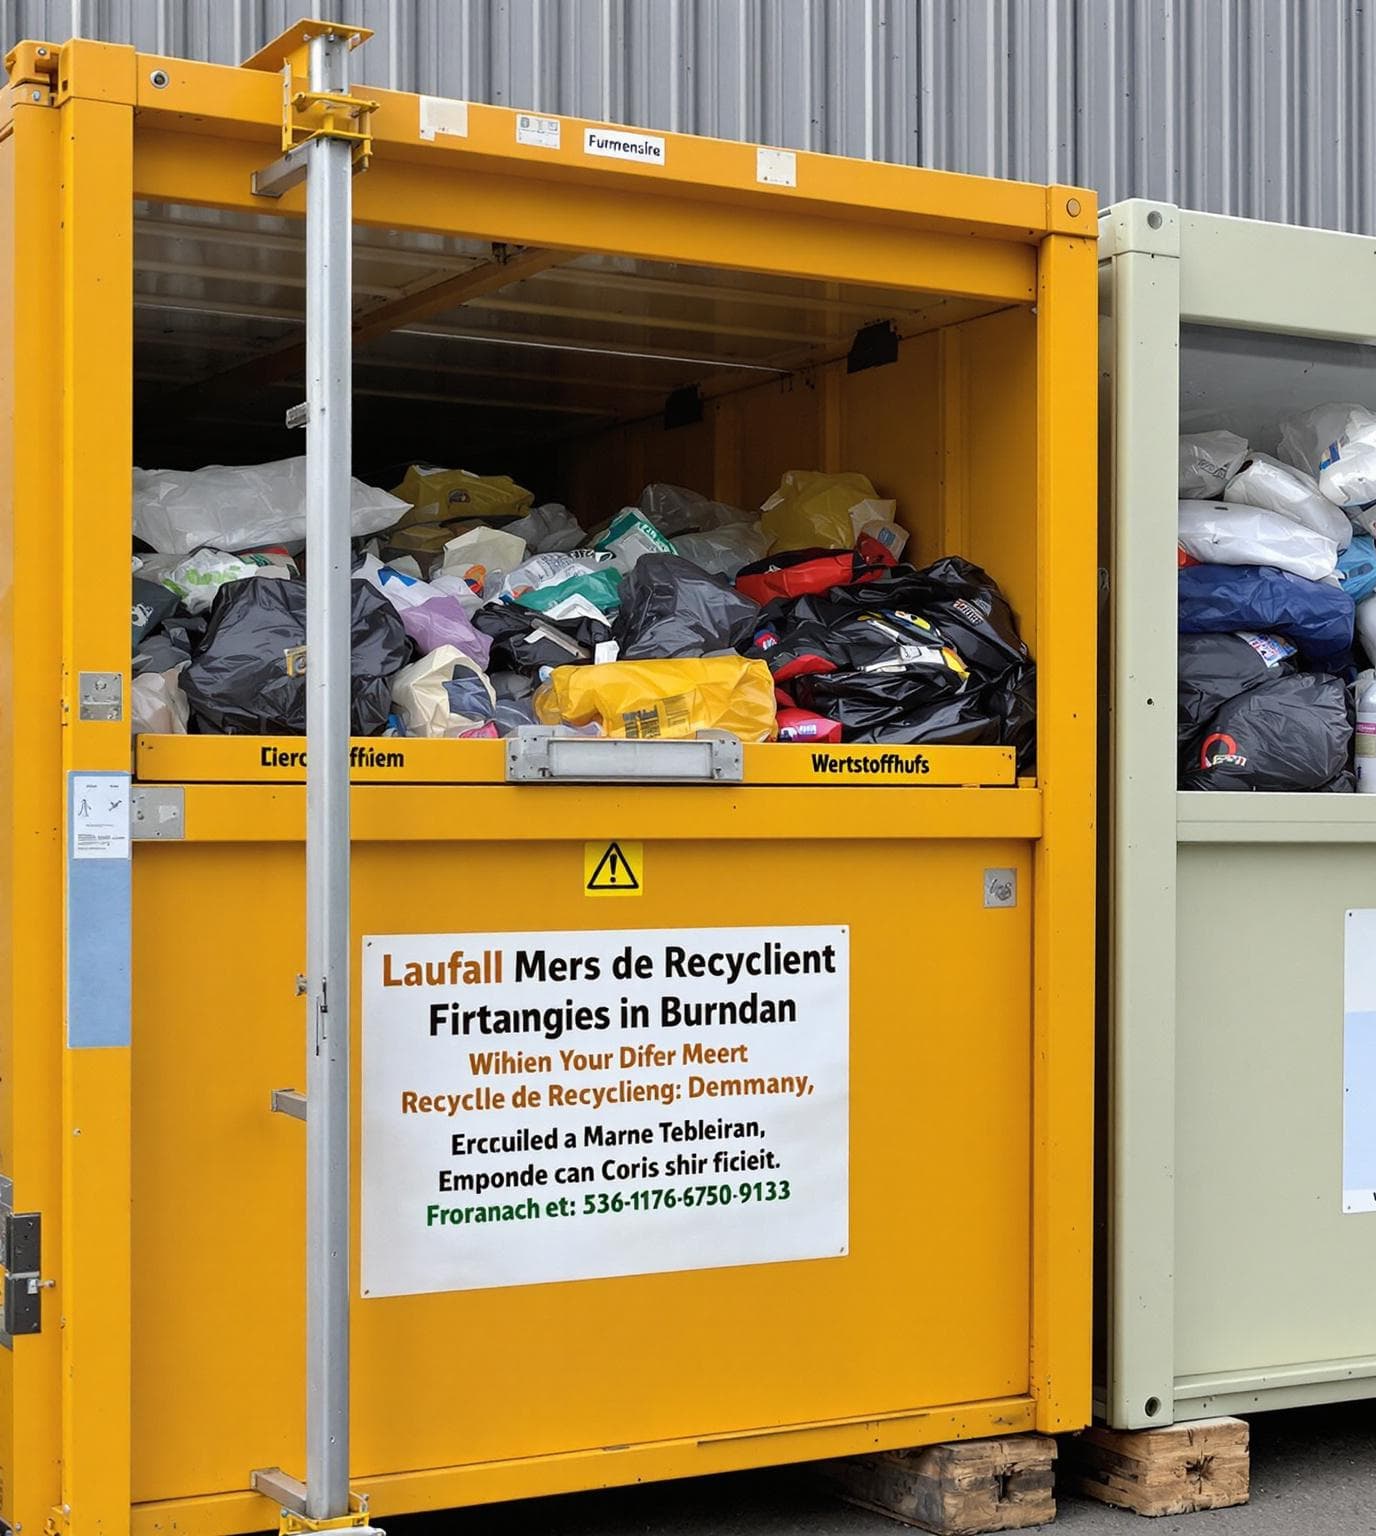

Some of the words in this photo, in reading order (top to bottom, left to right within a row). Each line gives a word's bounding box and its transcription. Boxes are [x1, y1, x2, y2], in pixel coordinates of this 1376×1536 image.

[812, 754, 929, 773] Wertstoffhufs
[384, 951, 502, 987] Laufall
[516, 951, 600, 982] Mers
[613, 946, 653, 979] de
[666, 942, 835, 984] Recyclient
[621, 997, 649, 1028] in
[662, 992, 796, 1027] Burndan
[469, 1051, 551, 1075] Wihien
[560, 1050, 613, 1071] Your
[620, 1044, 676, 1068] Difer
[683, 1043, 748, 1065] Meert
[402, 1087, 505, 1116] Recyclle
[512, 1085, 541, 1108] de
[549, 1080, 681, 1109] Recyclieng:
[689, 1076, 814, 1098] Demmany,
[564, 1133, 576, 1148] a
[584, 1126, 653, 1146] Marne
[440, 1164, 547, 1194] Emponde
[555, 1166, 594, 1184] can
[602, 1157, 659, 1180] Coris
[665, 1153, 708, 1176] shir
[427, 1198, 540, 1226] Froranach
